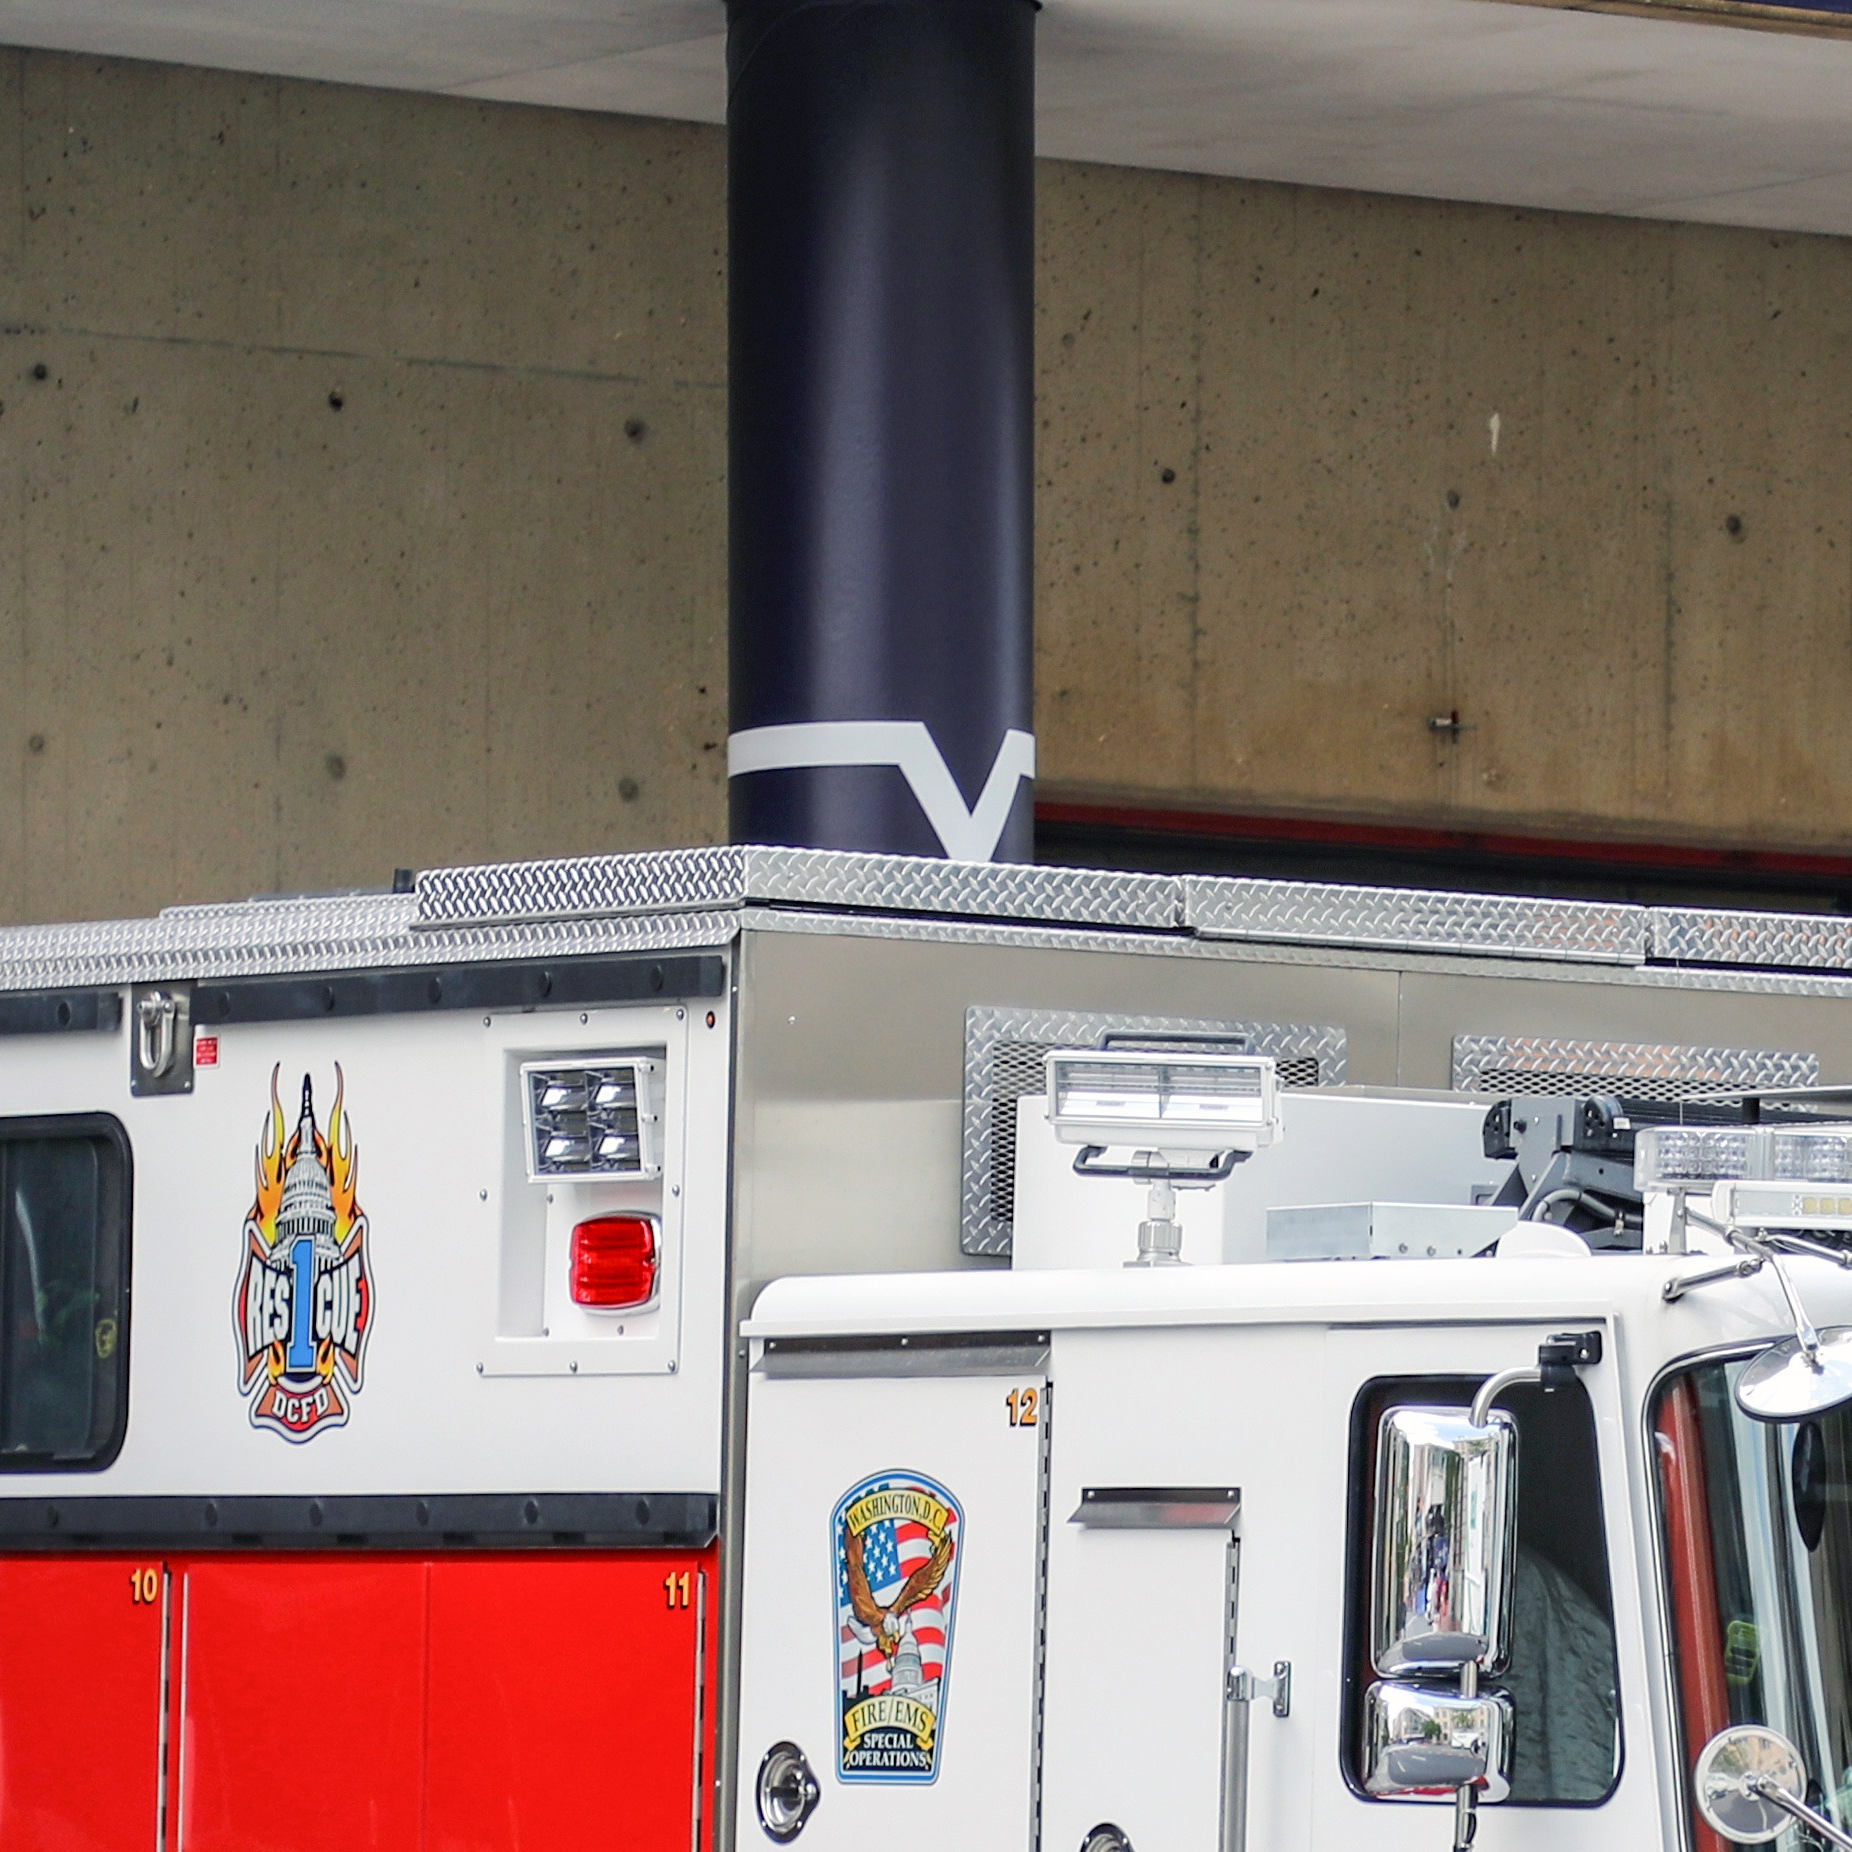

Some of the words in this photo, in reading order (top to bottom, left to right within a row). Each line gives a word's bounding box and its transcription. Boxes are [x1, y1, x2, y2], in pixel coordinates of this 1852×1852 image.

[272, 1389, 330, 1424] DCFD
[1006, 1388, 1038, 1427] 12
[129, 1568, 159, 1604] 10
[663, 1572, 691, 1609] 11
[849, 1750, 927, 1767] OPERATIONS
[863, 1733, 914, 1749] SPECIAL
